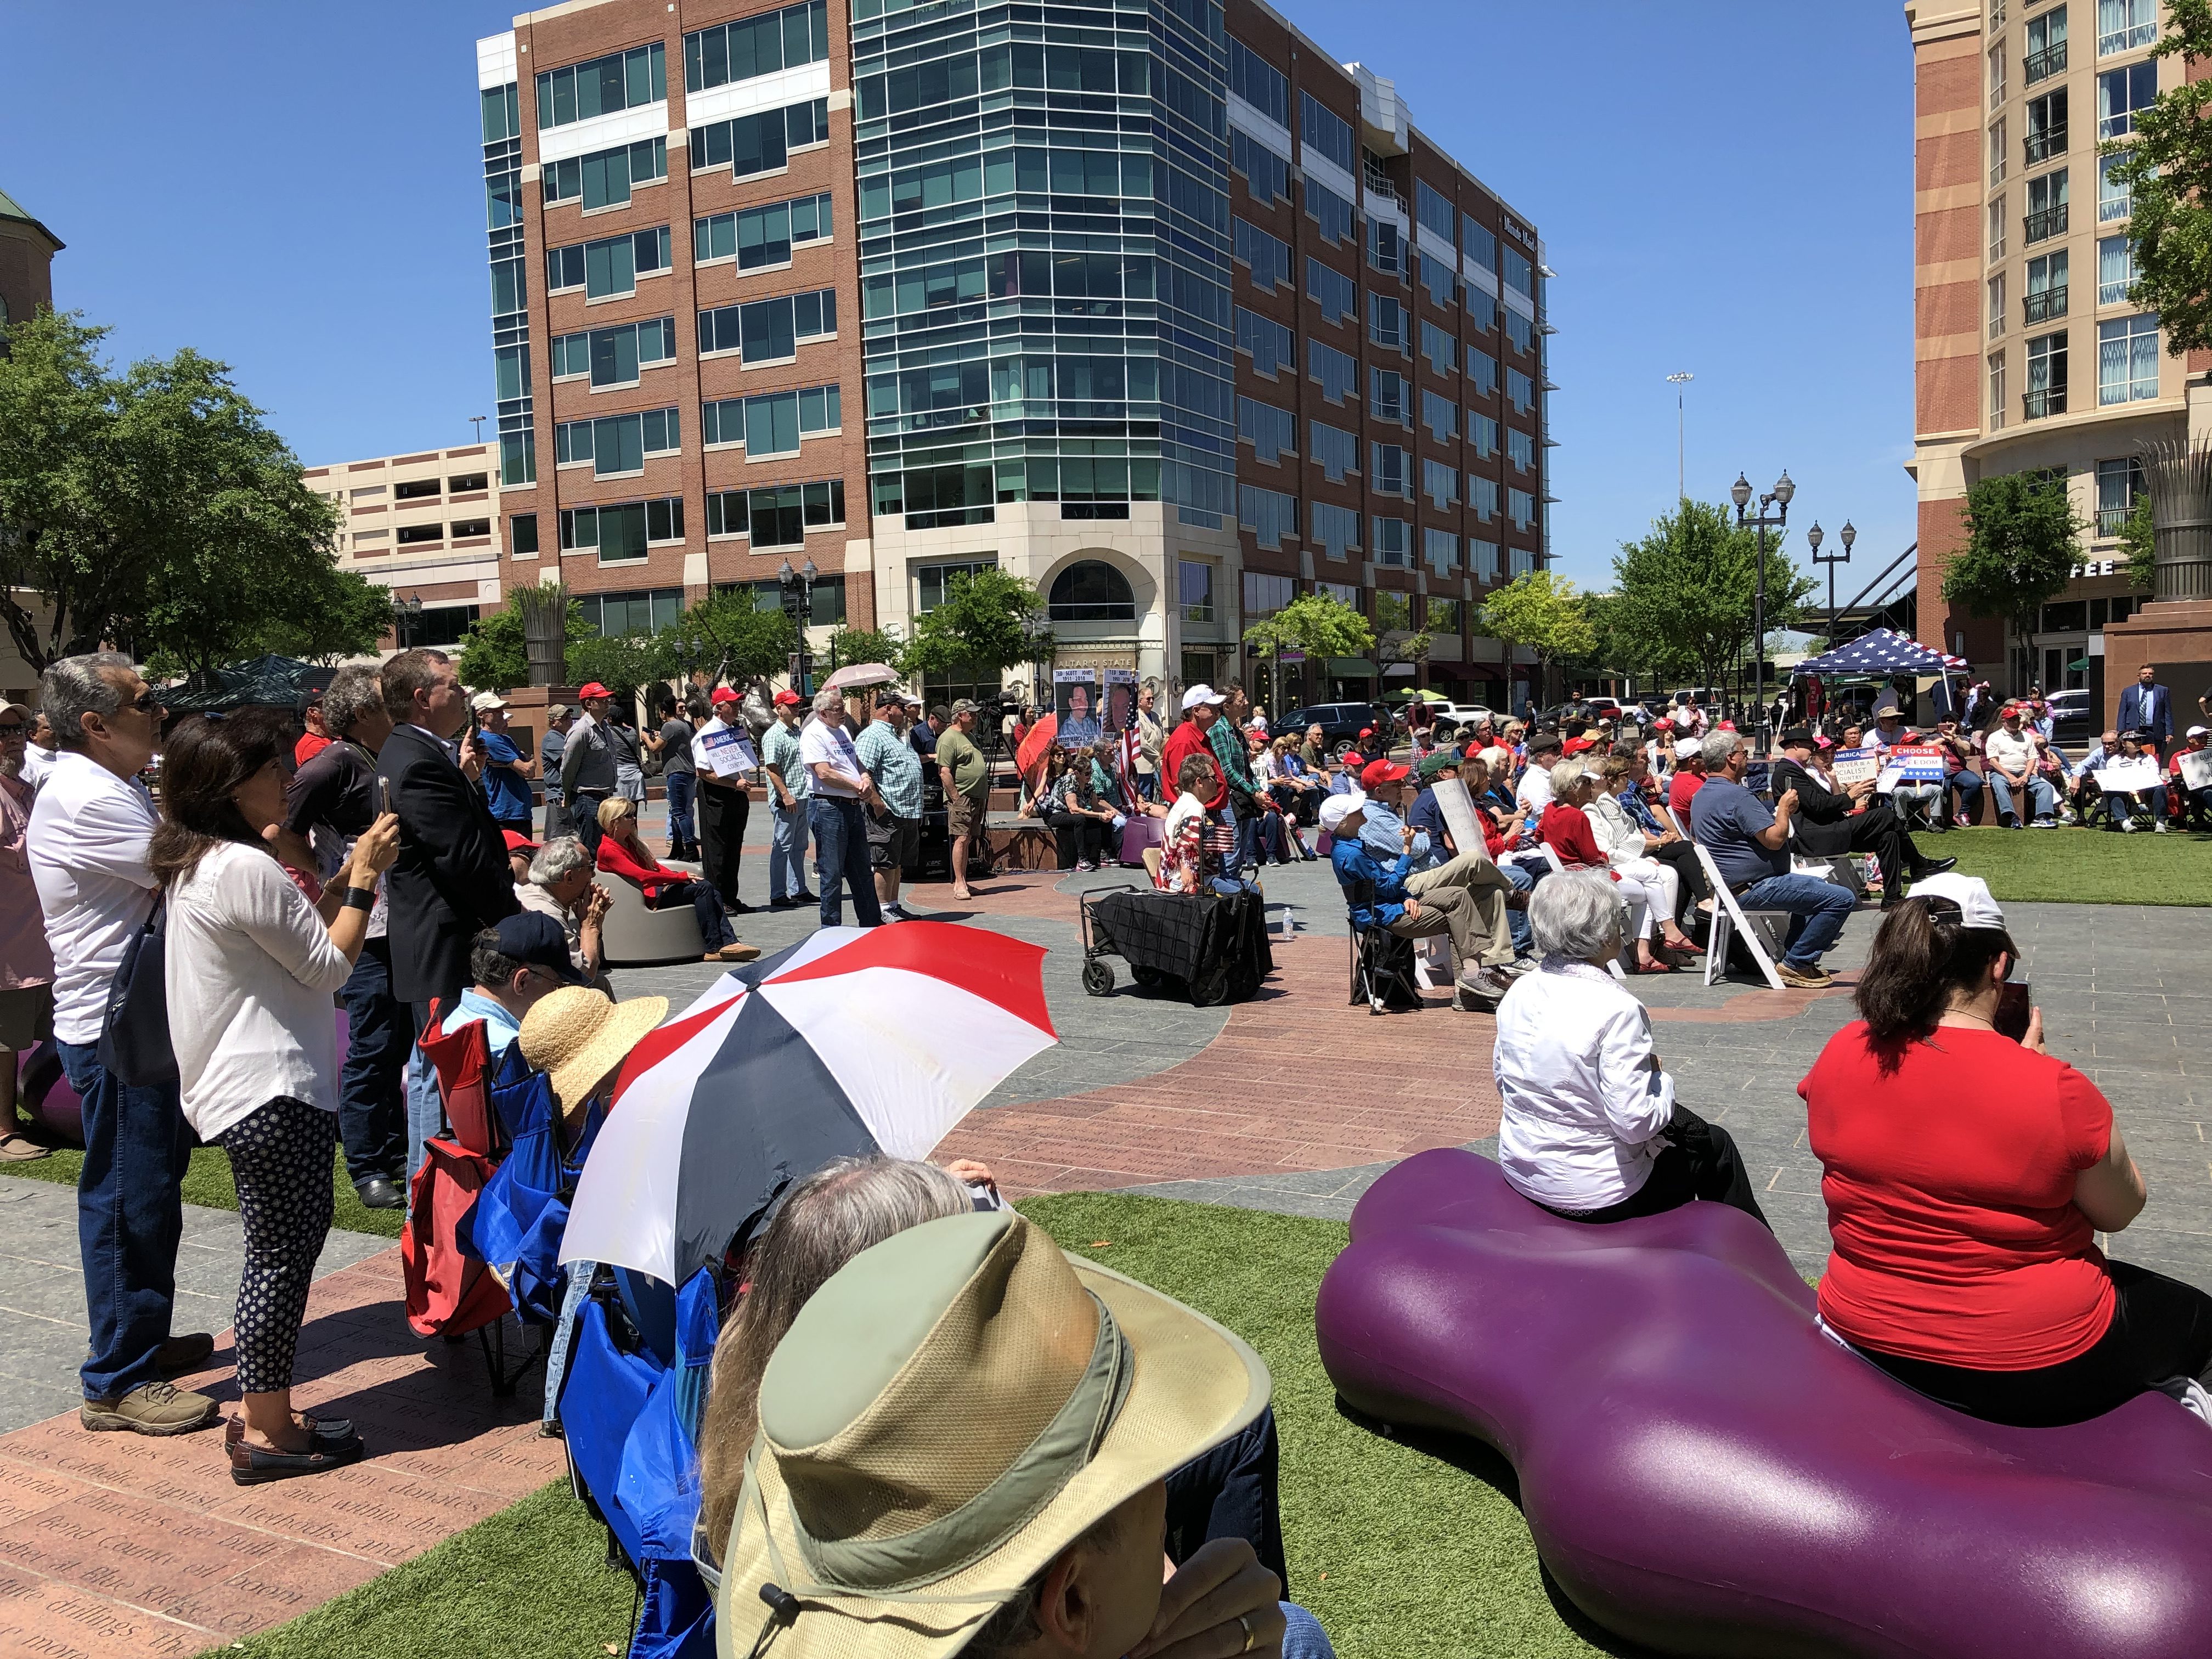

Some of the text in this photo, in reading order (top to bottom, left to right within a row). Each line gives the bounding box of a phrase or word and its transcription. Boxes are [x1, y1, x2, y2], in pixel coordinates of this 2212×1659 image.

[2069, 559, 2114, 578] FEE
[150, 682, 167, 691] OOMS
[713, 732, 735, 744] AMERICA
[719, 751, 746, 764] SOCIALIST
[720, 745, 738, 755] NEVER
[727, 760, 746, 770] COUNTRY
[1835, 767, 1866, 776] OCIALIST
[1836, 760, 1859, 769] NEVER
[470, 1447, 556, 1474] church
[46, 1427, 114, 1447] corner
[120, 1443, 163, 1460] sites
[163, 1458, 189, 1469] in
[283, 1487, 334, 1504] and
[331, 1498, 400, 1524] within
[57, 1456, 139, 1487] Catholic
[143, 1480, 221, 1509] Baptist
[230, 1503, 353, 1543] Methodist
[354, 1538, 415, 1559] and
[387, 1479, 480, 1513] donates
[74, 1493, 172, 1527] churches
[217, 1532, 278, 1558] built
[36, 1515, 106, 1540] Bend
[98, 1536, 180, 1566] County
[222, 1571, 304, 1605] boom
[79, 1566, 136, 1590] Blue
[135, 1584, 212, 1617] Ridge
[46, 1598, 143, 1638] drillings
